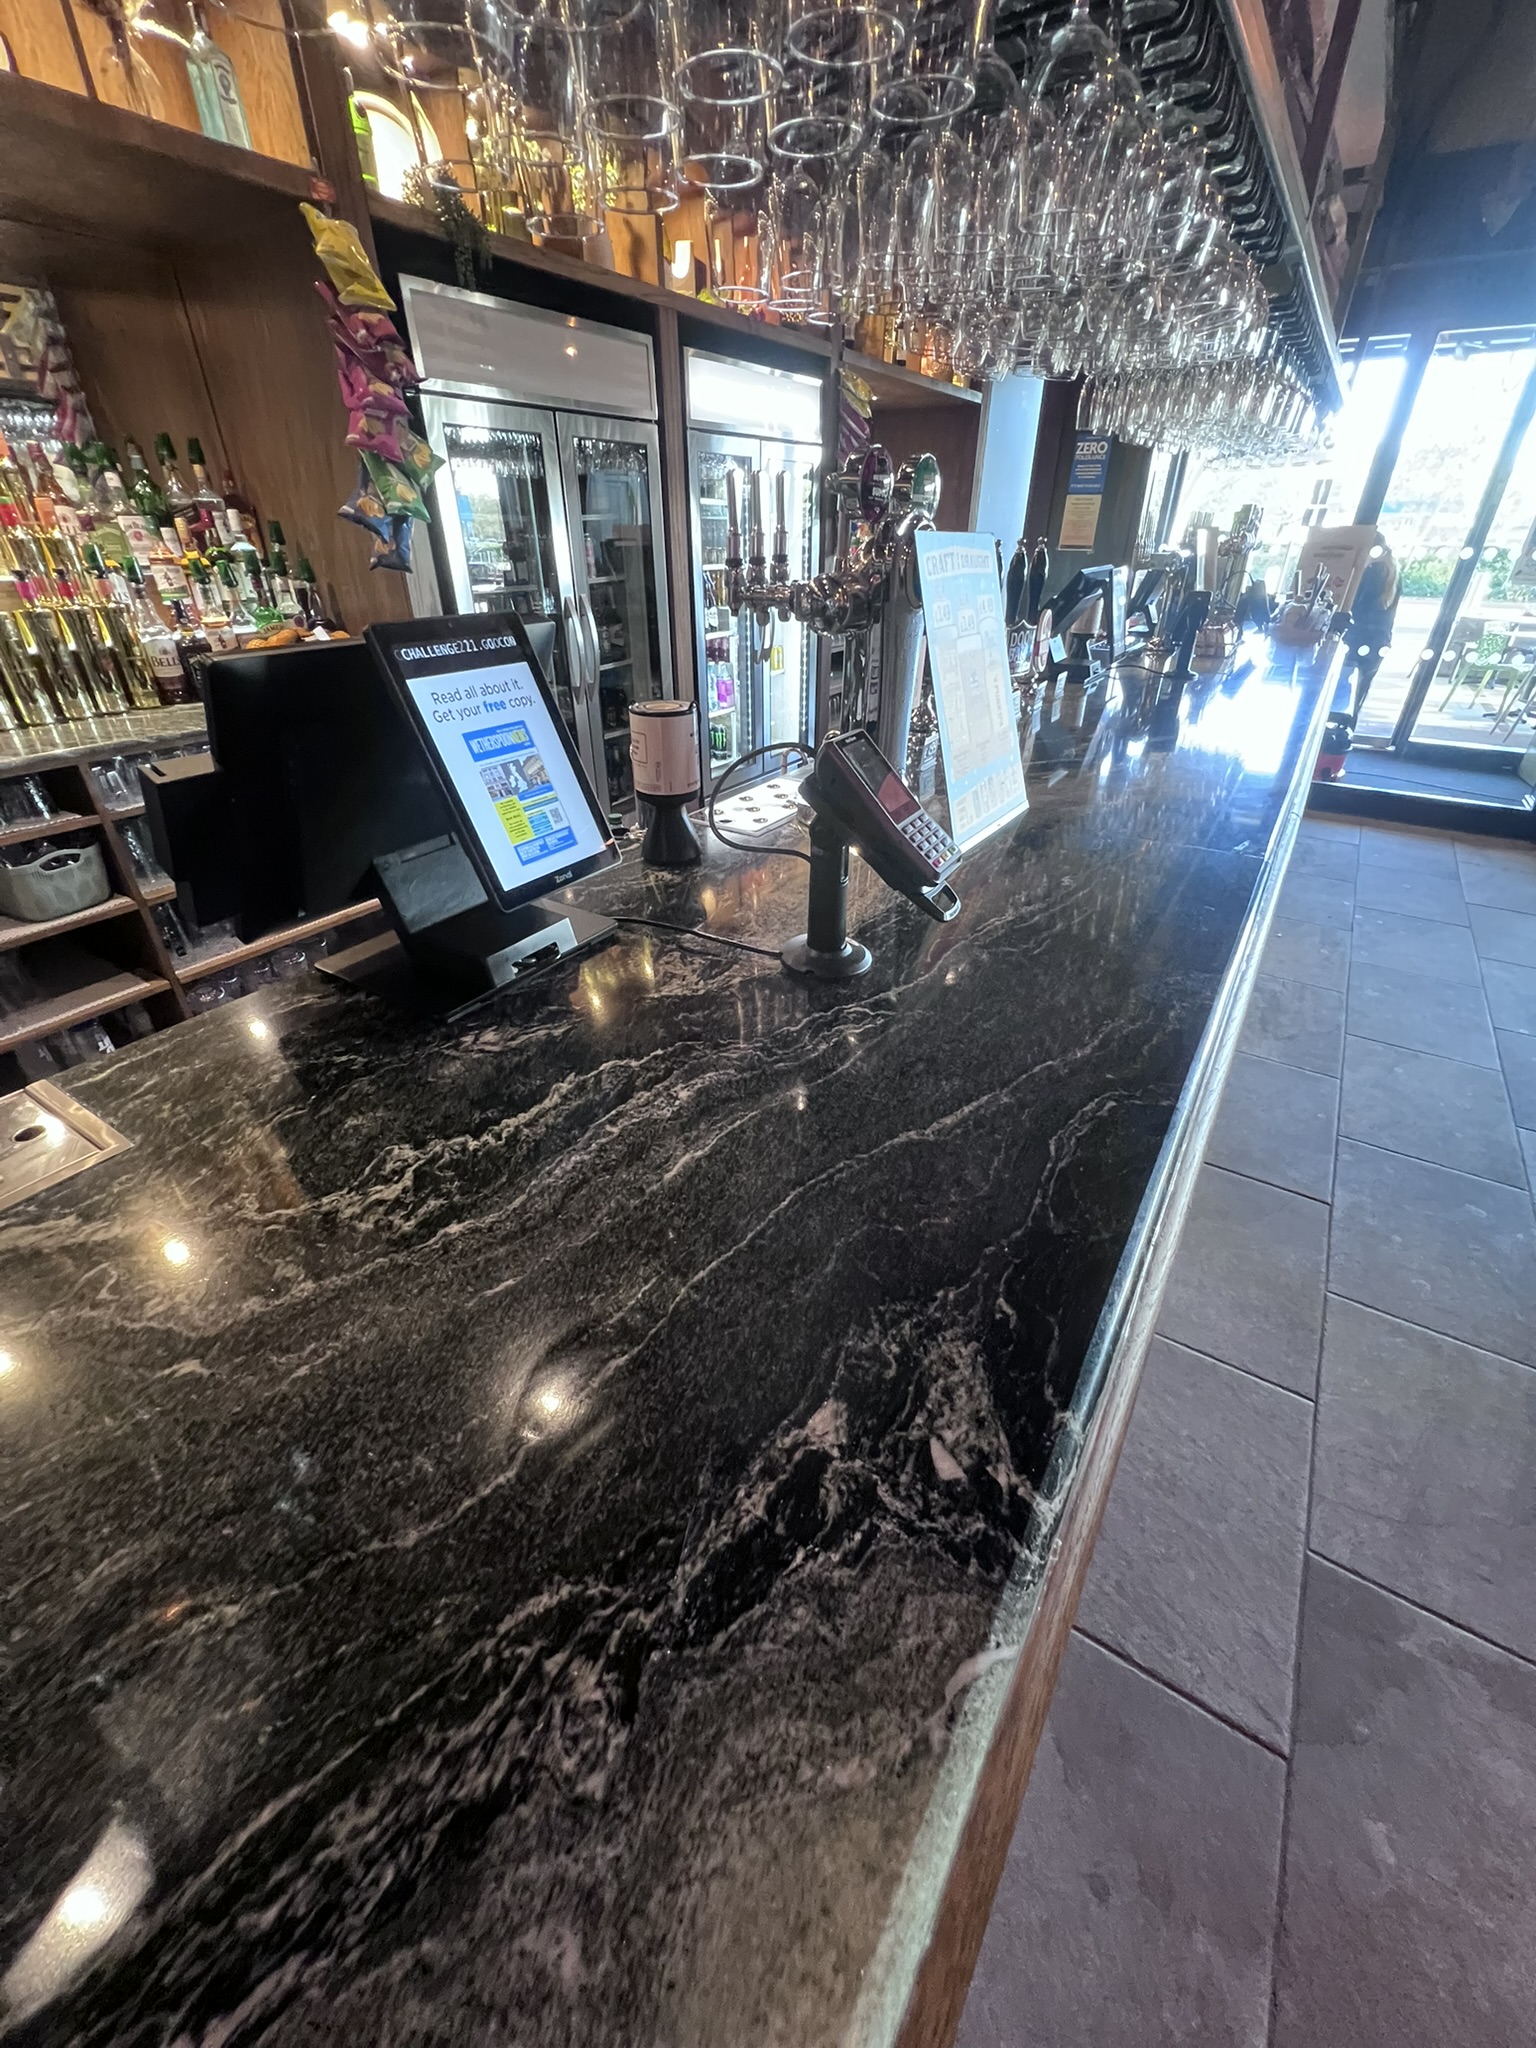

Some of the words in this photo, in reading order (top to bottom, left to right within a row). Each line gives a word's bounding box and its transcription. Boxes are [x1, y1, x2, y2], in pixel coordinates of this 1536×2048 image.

[1075, 441, 1108, 454] ZERO
[926, 552, 955, 576] CRAFT
[431, 688, 463, 705] Read
[464, 685, 479, 700] all
[480, 680, 511, 697] about
[510, 678, 524, 691] it.
[433, 708, 456, 723] Get
[456, 705, 482, 721] your
[483, 700, 507, 713] free
[509, 694, 536, 709] copy.
